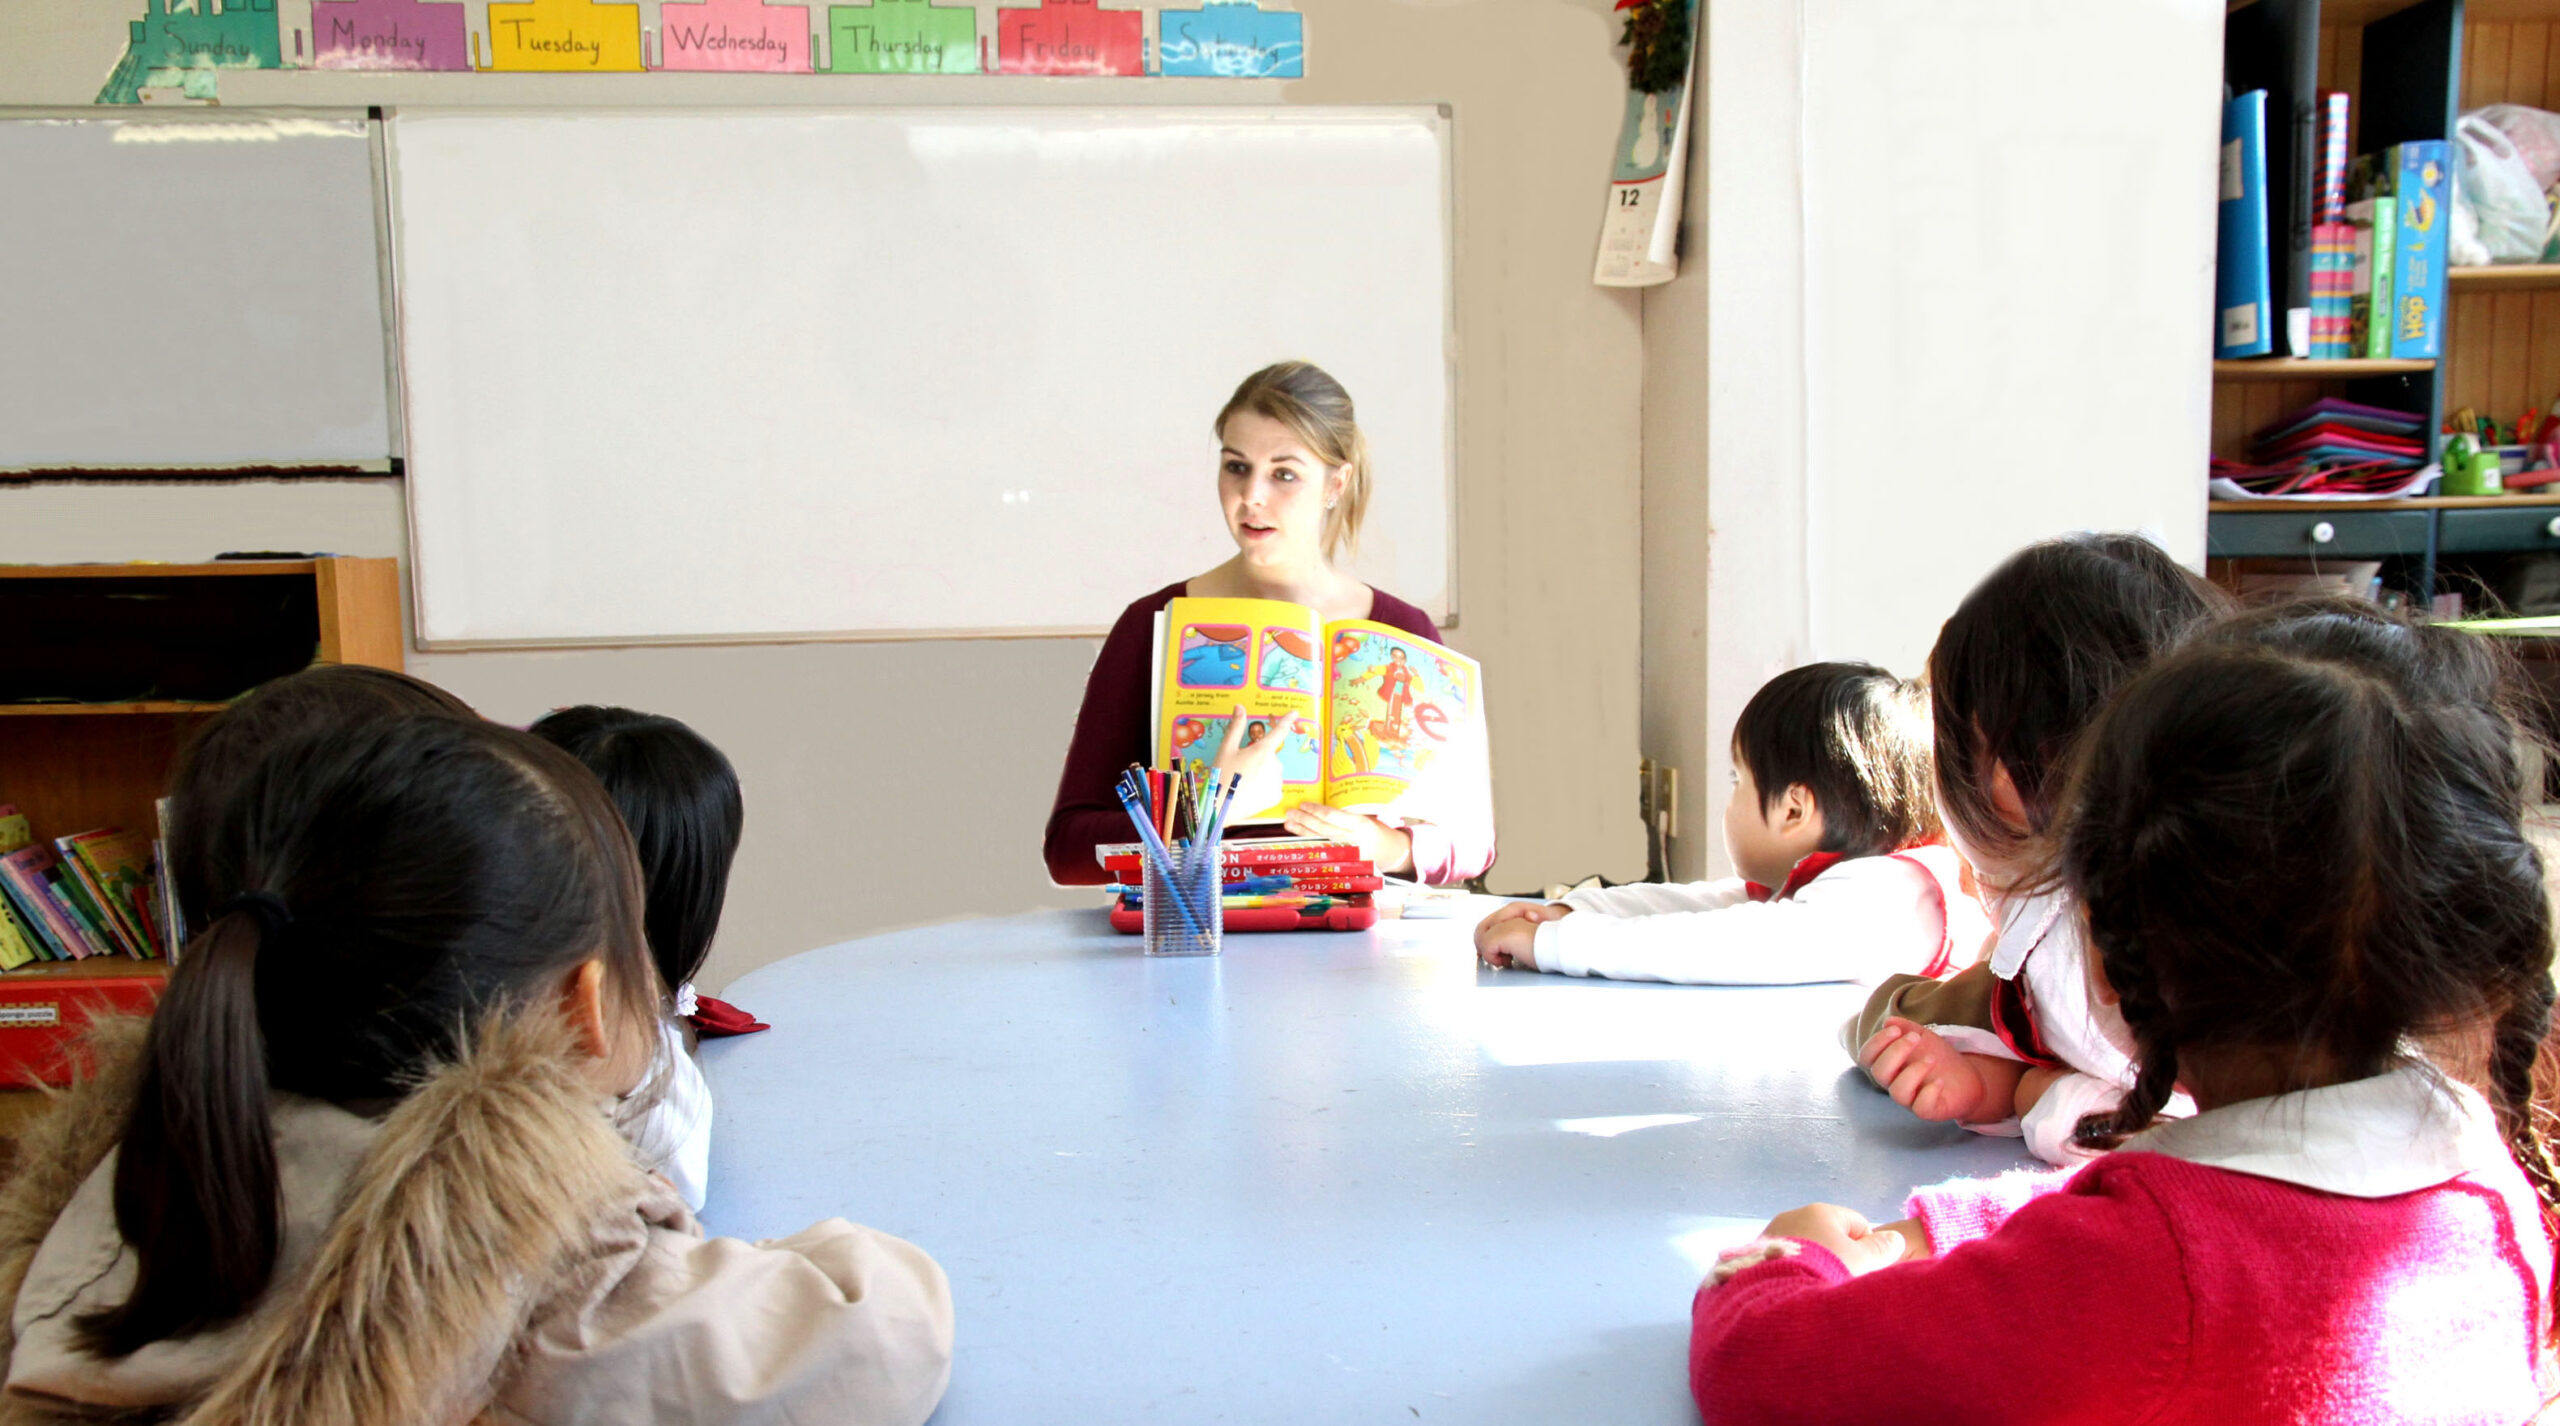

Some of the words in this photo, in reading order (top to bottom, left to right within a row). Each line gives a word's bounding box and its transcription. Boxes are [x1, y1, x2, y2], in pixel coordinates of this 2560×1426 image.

[162, 21, 251, 64] Sunday
[332, 16, 425, 63] Monday
[499, 18, 600, 65] Tuesday
[670, 23, 788, 63] Wednesday
[841, 24, 943, 70] Thursday
[1019, 22, 1097, 70] Friday
[1620, 187, 1641, 207] 12
[2407, 296, 2428, 340] Hop
